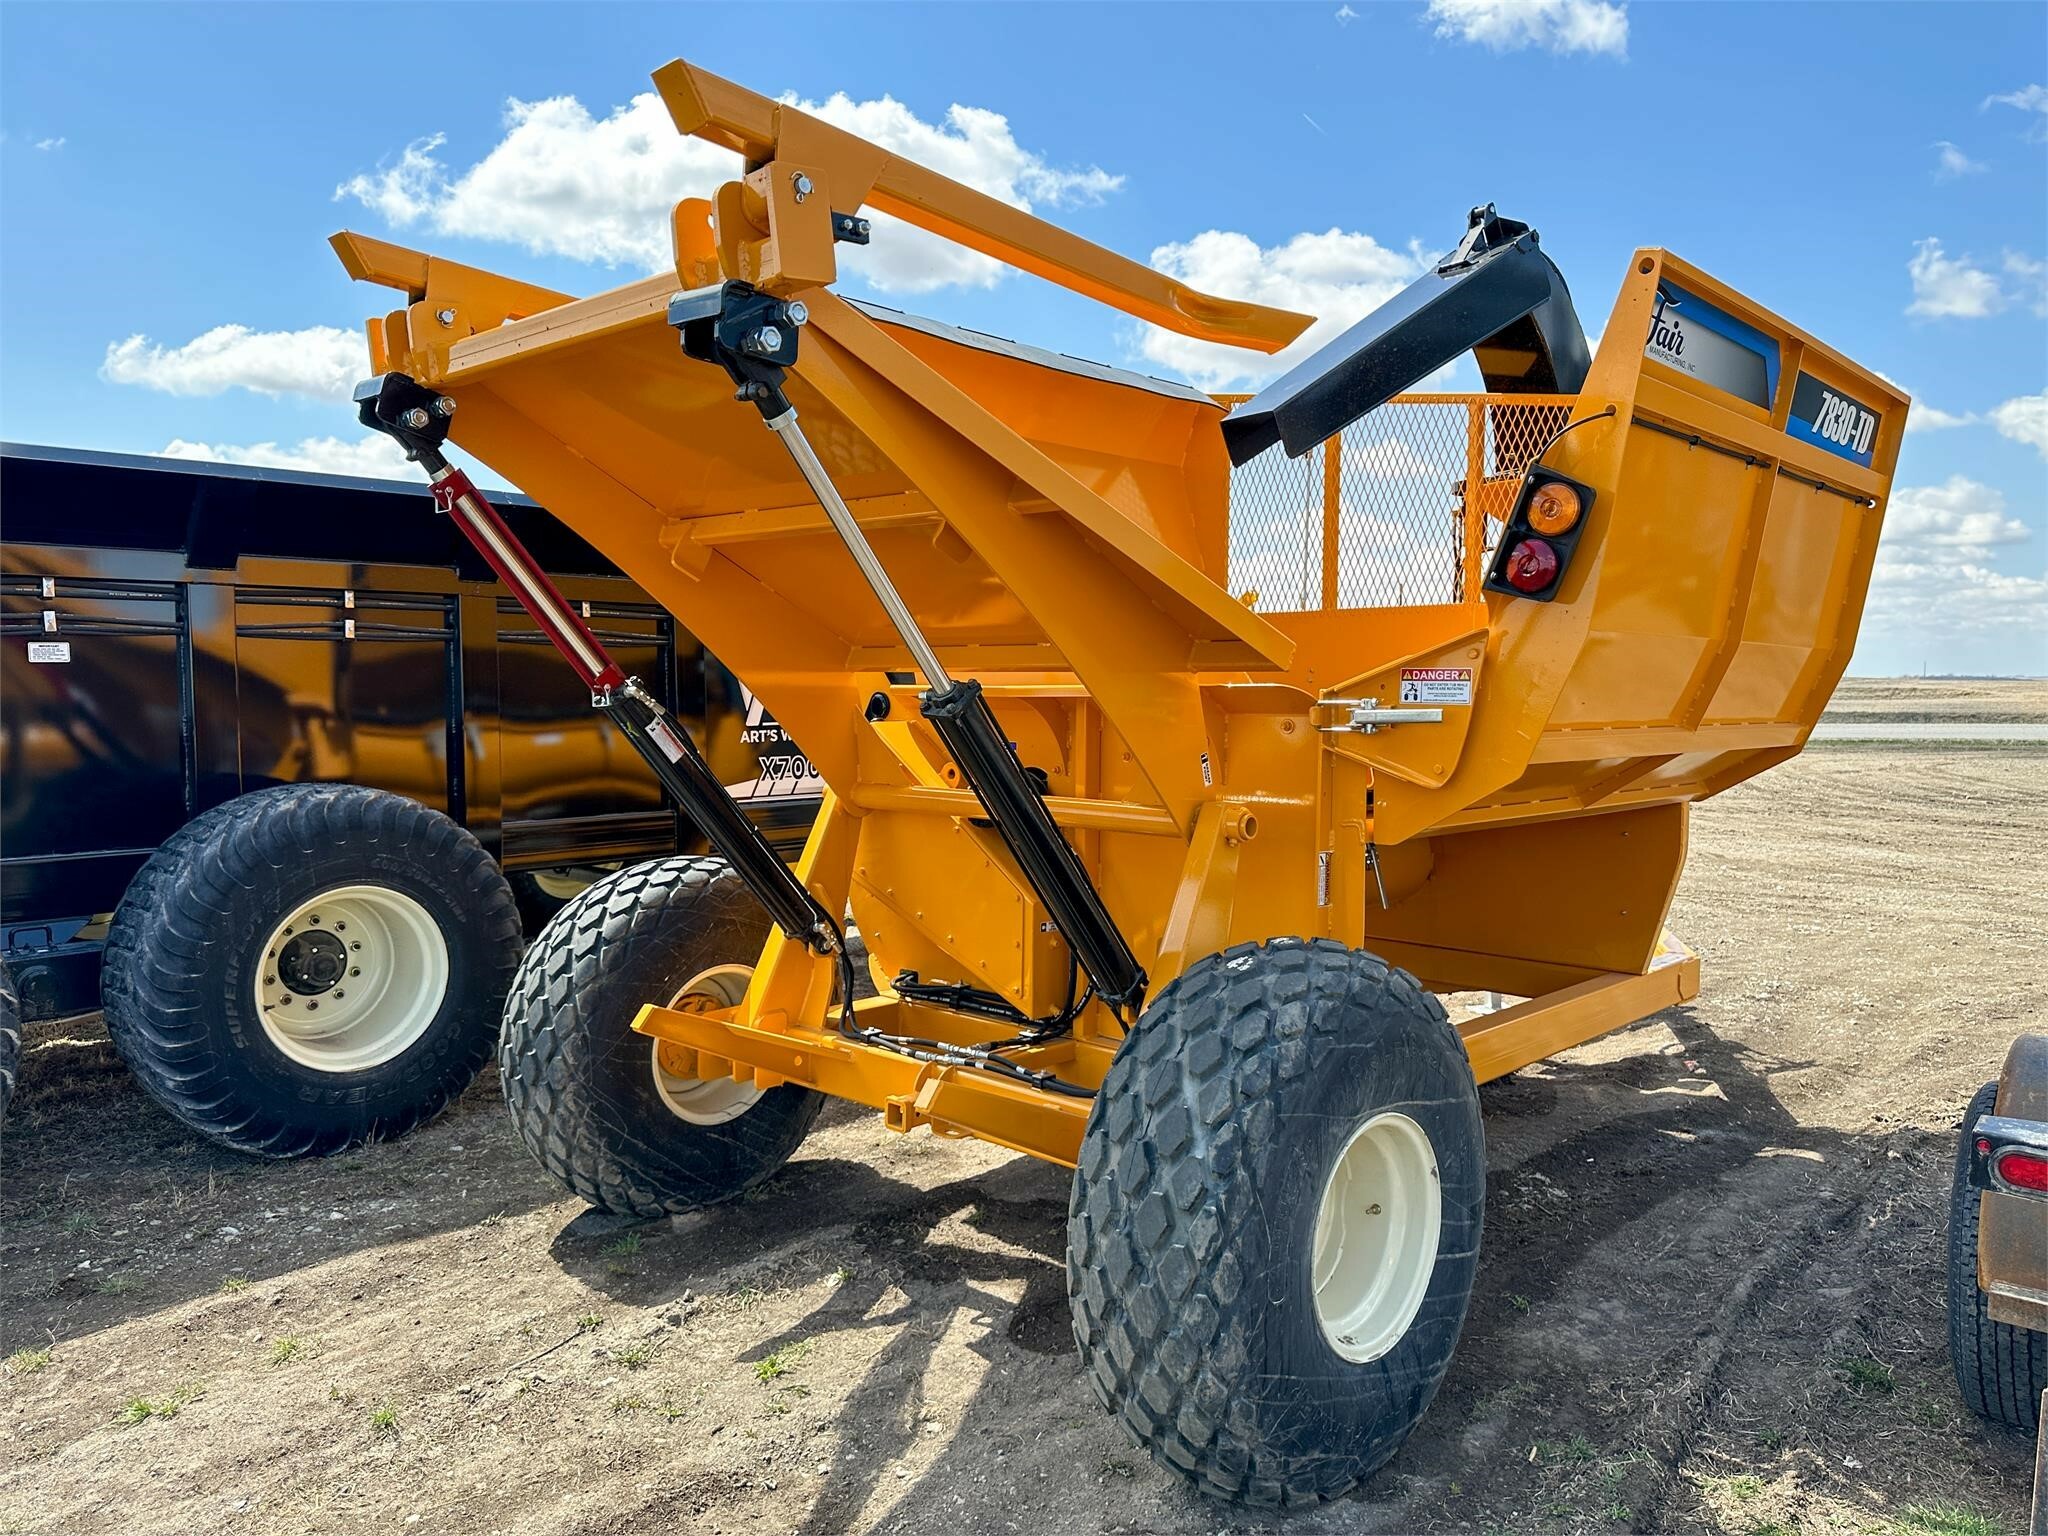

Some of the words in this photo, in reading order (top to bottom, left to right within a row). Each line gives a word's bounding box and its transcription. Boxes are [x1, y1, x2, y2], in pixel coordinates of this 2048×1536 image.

[1646, 282, 1686, 356] Fair
[1811, 390, 1875, 454] 7830-TD
[1412, 670, 1459, 680] DANGER
[740, 729, 778, 743] ART'S
